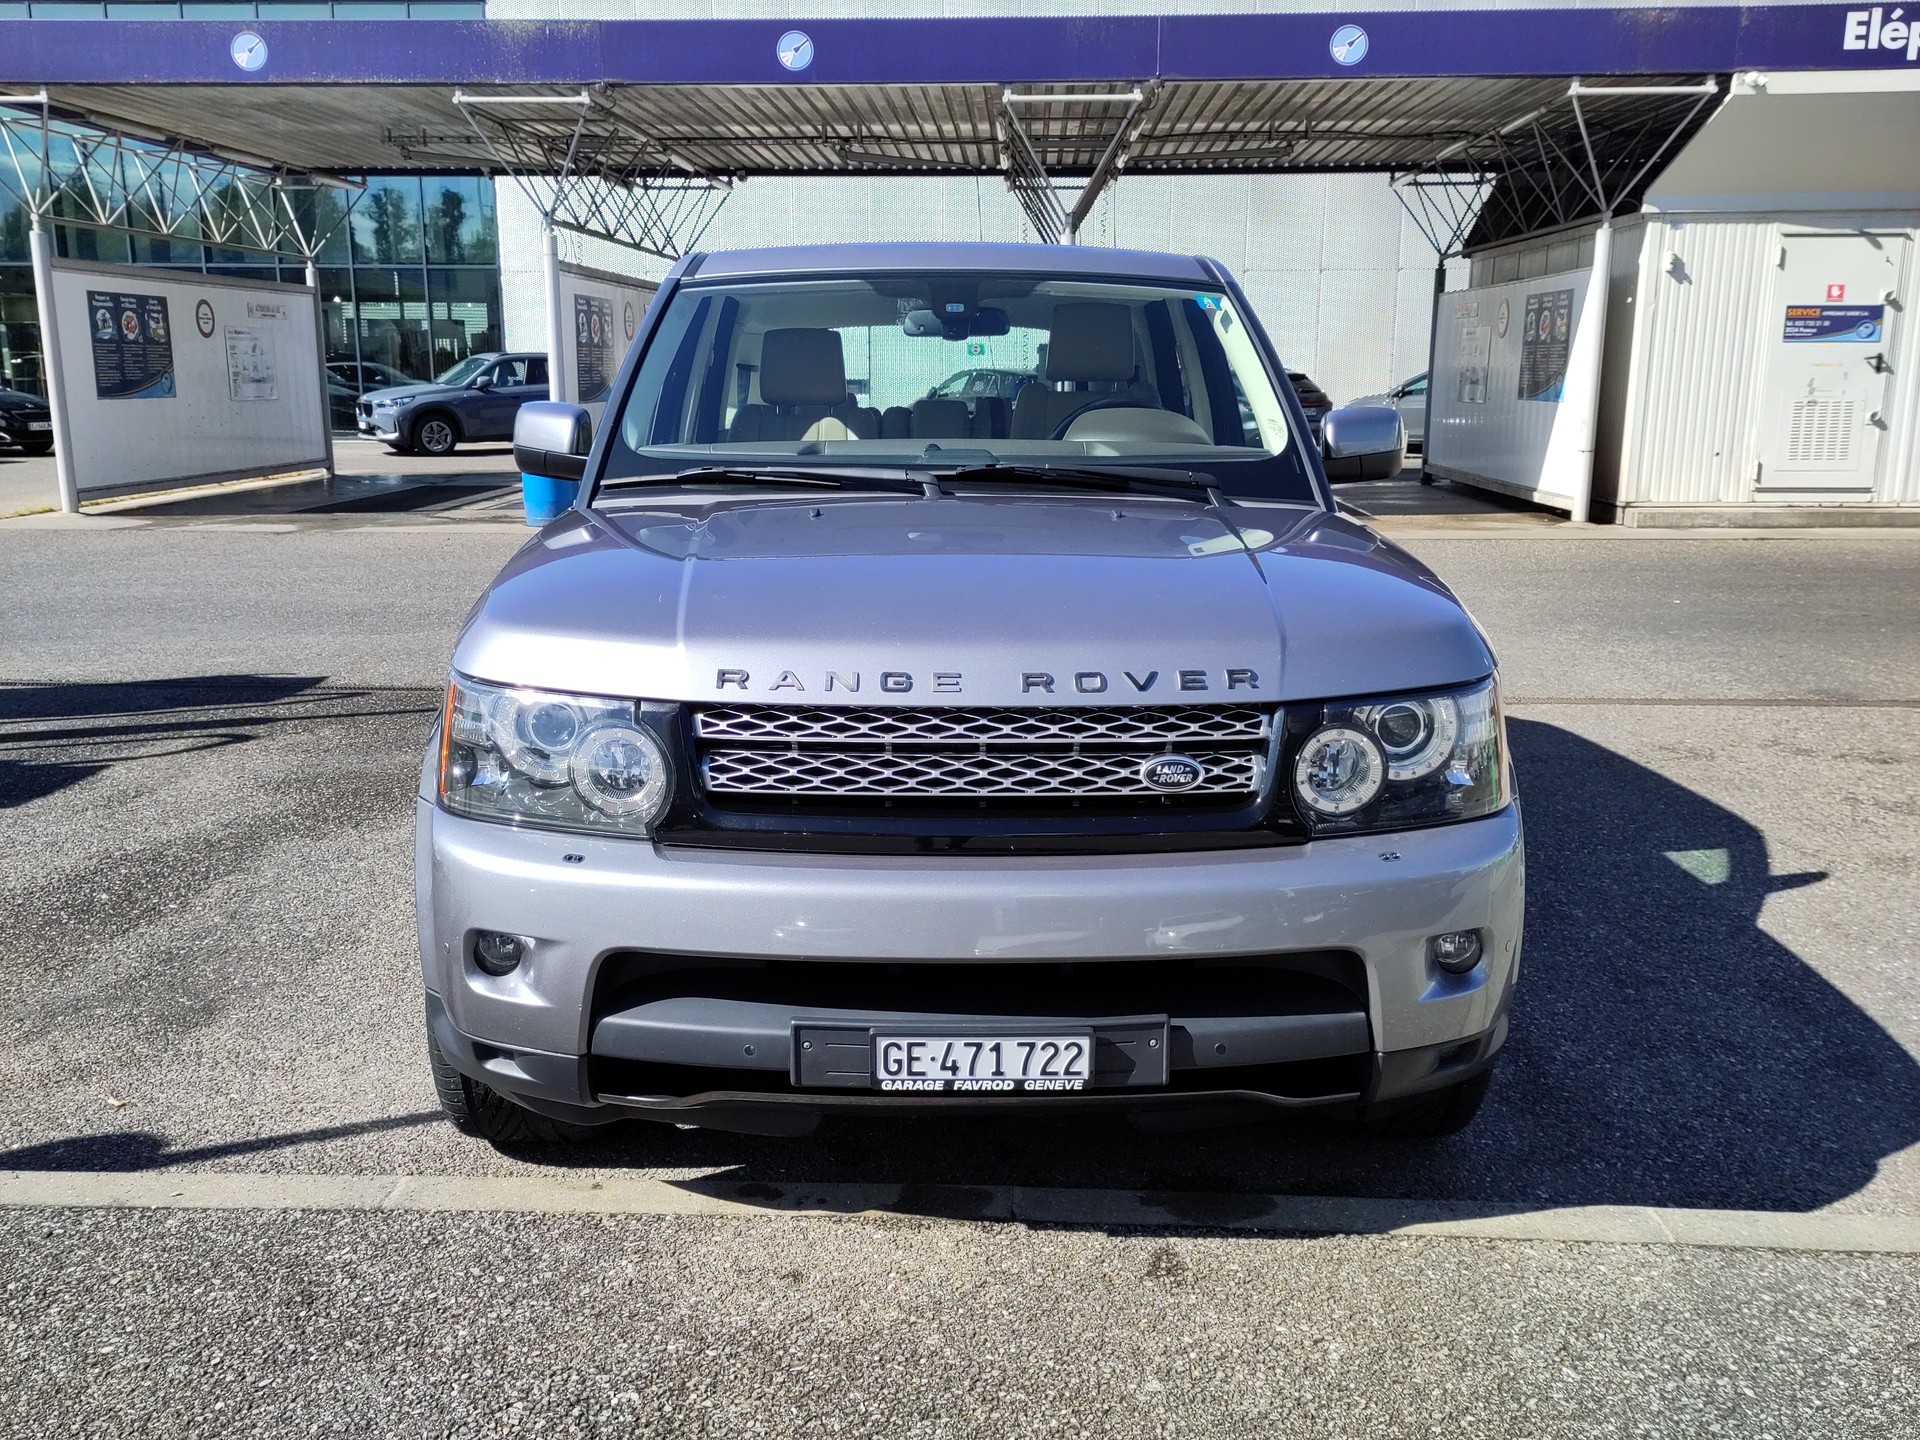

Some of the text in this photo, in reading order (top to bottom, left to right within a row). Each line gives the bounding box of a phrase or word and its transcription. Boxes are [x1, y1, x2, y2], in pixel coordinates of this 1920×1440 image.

[1787, 308, 1820, 316] SERVICE
[716, 668, 1260, 694] RANGE ROVER
[1156, 765, 1184, 774] LAND
[1159, 774, 1193, 783] ROVER
[881, 1079, 1084, 1091] GARAGE FAVROD GENEVE
